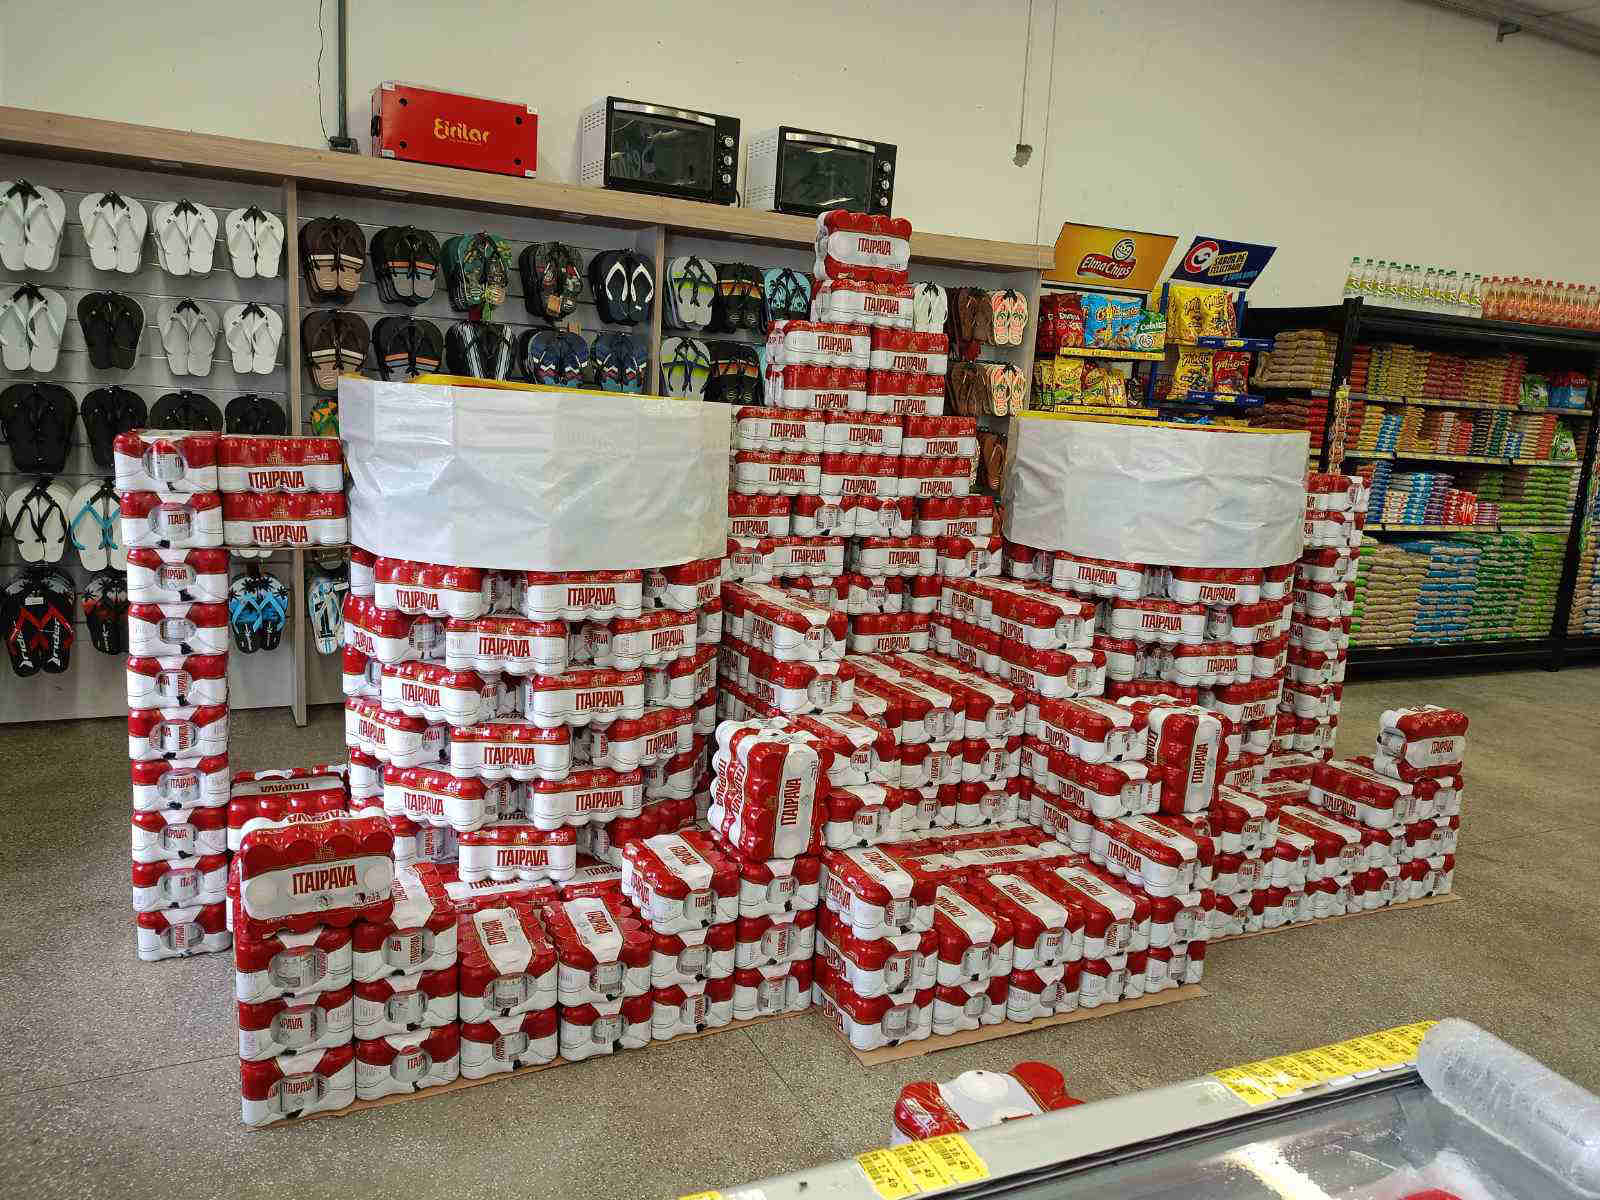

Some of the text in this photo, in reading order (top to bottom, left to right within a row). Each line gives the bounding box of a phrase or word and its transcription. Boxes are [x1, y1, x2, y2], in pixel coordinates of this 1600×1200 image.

[858, 237, 893, 255] ITAIPAVA
[1081, 256, 1132, 279] Elma Chips
[864, 296, 899, 314] ITAIPAVA
[817, 336, 852, 352] ITAIPAVA
[894, 355, 928, 371] ITAIPAVA
[815, 394, 849, 409] ITAIPAVA
[894, 399, 926, 414] ITAIPAVA
[770, 423, 806, 439] ITAIPAVA
[849, 427, 883, 444] ITAIPAVA
[926, 440, 959, 455] ITAIPAVA
[248, 470, 305, 489] ITAIPAVA
[768, 467, 805, 482] ITAIPAVA
[842, 479, 877, 495] ITAIPAVA
[920, 481, 952, 496] ITAIPAVA
[252, 525, 308, 544] ITAIPAVA
[732, 521, 768, 535] ITAIPAVA
[946, 522, 977, 536] ITAIPAVA
[791, 550, 826, 564] ITAIPAVA
[888, 551, 920, 565] ITAIPAVA
[1077, 566, 1117, 585] ITAIPAVA
[396, 590, 439, 610] ITAIPAVA
[567, 586, 617, 607] ITAIPAVA
[1200, 587, 1236, 602] ITAIPAVA
[1141, 614, 1182, 631] ITAIPAVA
[478, 637, 531, 657] ITAIPAVA
[652, 629, 685, 650] ITAIPAVA
[877, 635, 911, 650] ITAIPAVA
[1206, 656, 1239, 673] ITAIPAVA
[402, 684, 441, 706] ITAIPAVA
[576, 690, 625, 710] ITAIPAVA
[646, 731, 678, 754] ITAIPAVA
[1045, 726, 1071, 750] ITAIPAVA
[1430, 740, 1454, 754] ITAIPAVA
[484, 747, 536, 766] ITAIPAVA
[1191, 743, 1209, 784] ITAIPAVA
[576, 791, 625, 811] ITAIPAVA
[780, 777, 802, 825] ITAIPAVA
[1058, 780, 1086, 804] ITAIPAVA
[404, 791, 443, 816] ITAIPAVA
[1322, 793, 1357, 818] ITAIPAVA
[1043, 804, 1070, 833] ITAIPAVA
[497, 849, 549, 866] ITAIPAVA
[669, 846, 702, 865] ITAIPAVA
[863, 849, 898, 874] ITAIPAVA
[1107, 842, 1142, 871] ITAIPAVA
[293, 866, 357, 894] ITAIPAVA
[1072, 875, 1109, 897] ITAIPAVA
[1002, 883, 1040, 905] ITAIPAVA
[936, 891, 965, 918] ITAIPAVA
[482, 920, 508, 945] ITAIPAVA
[585, 911, 613, 935] ITAIPAVA
